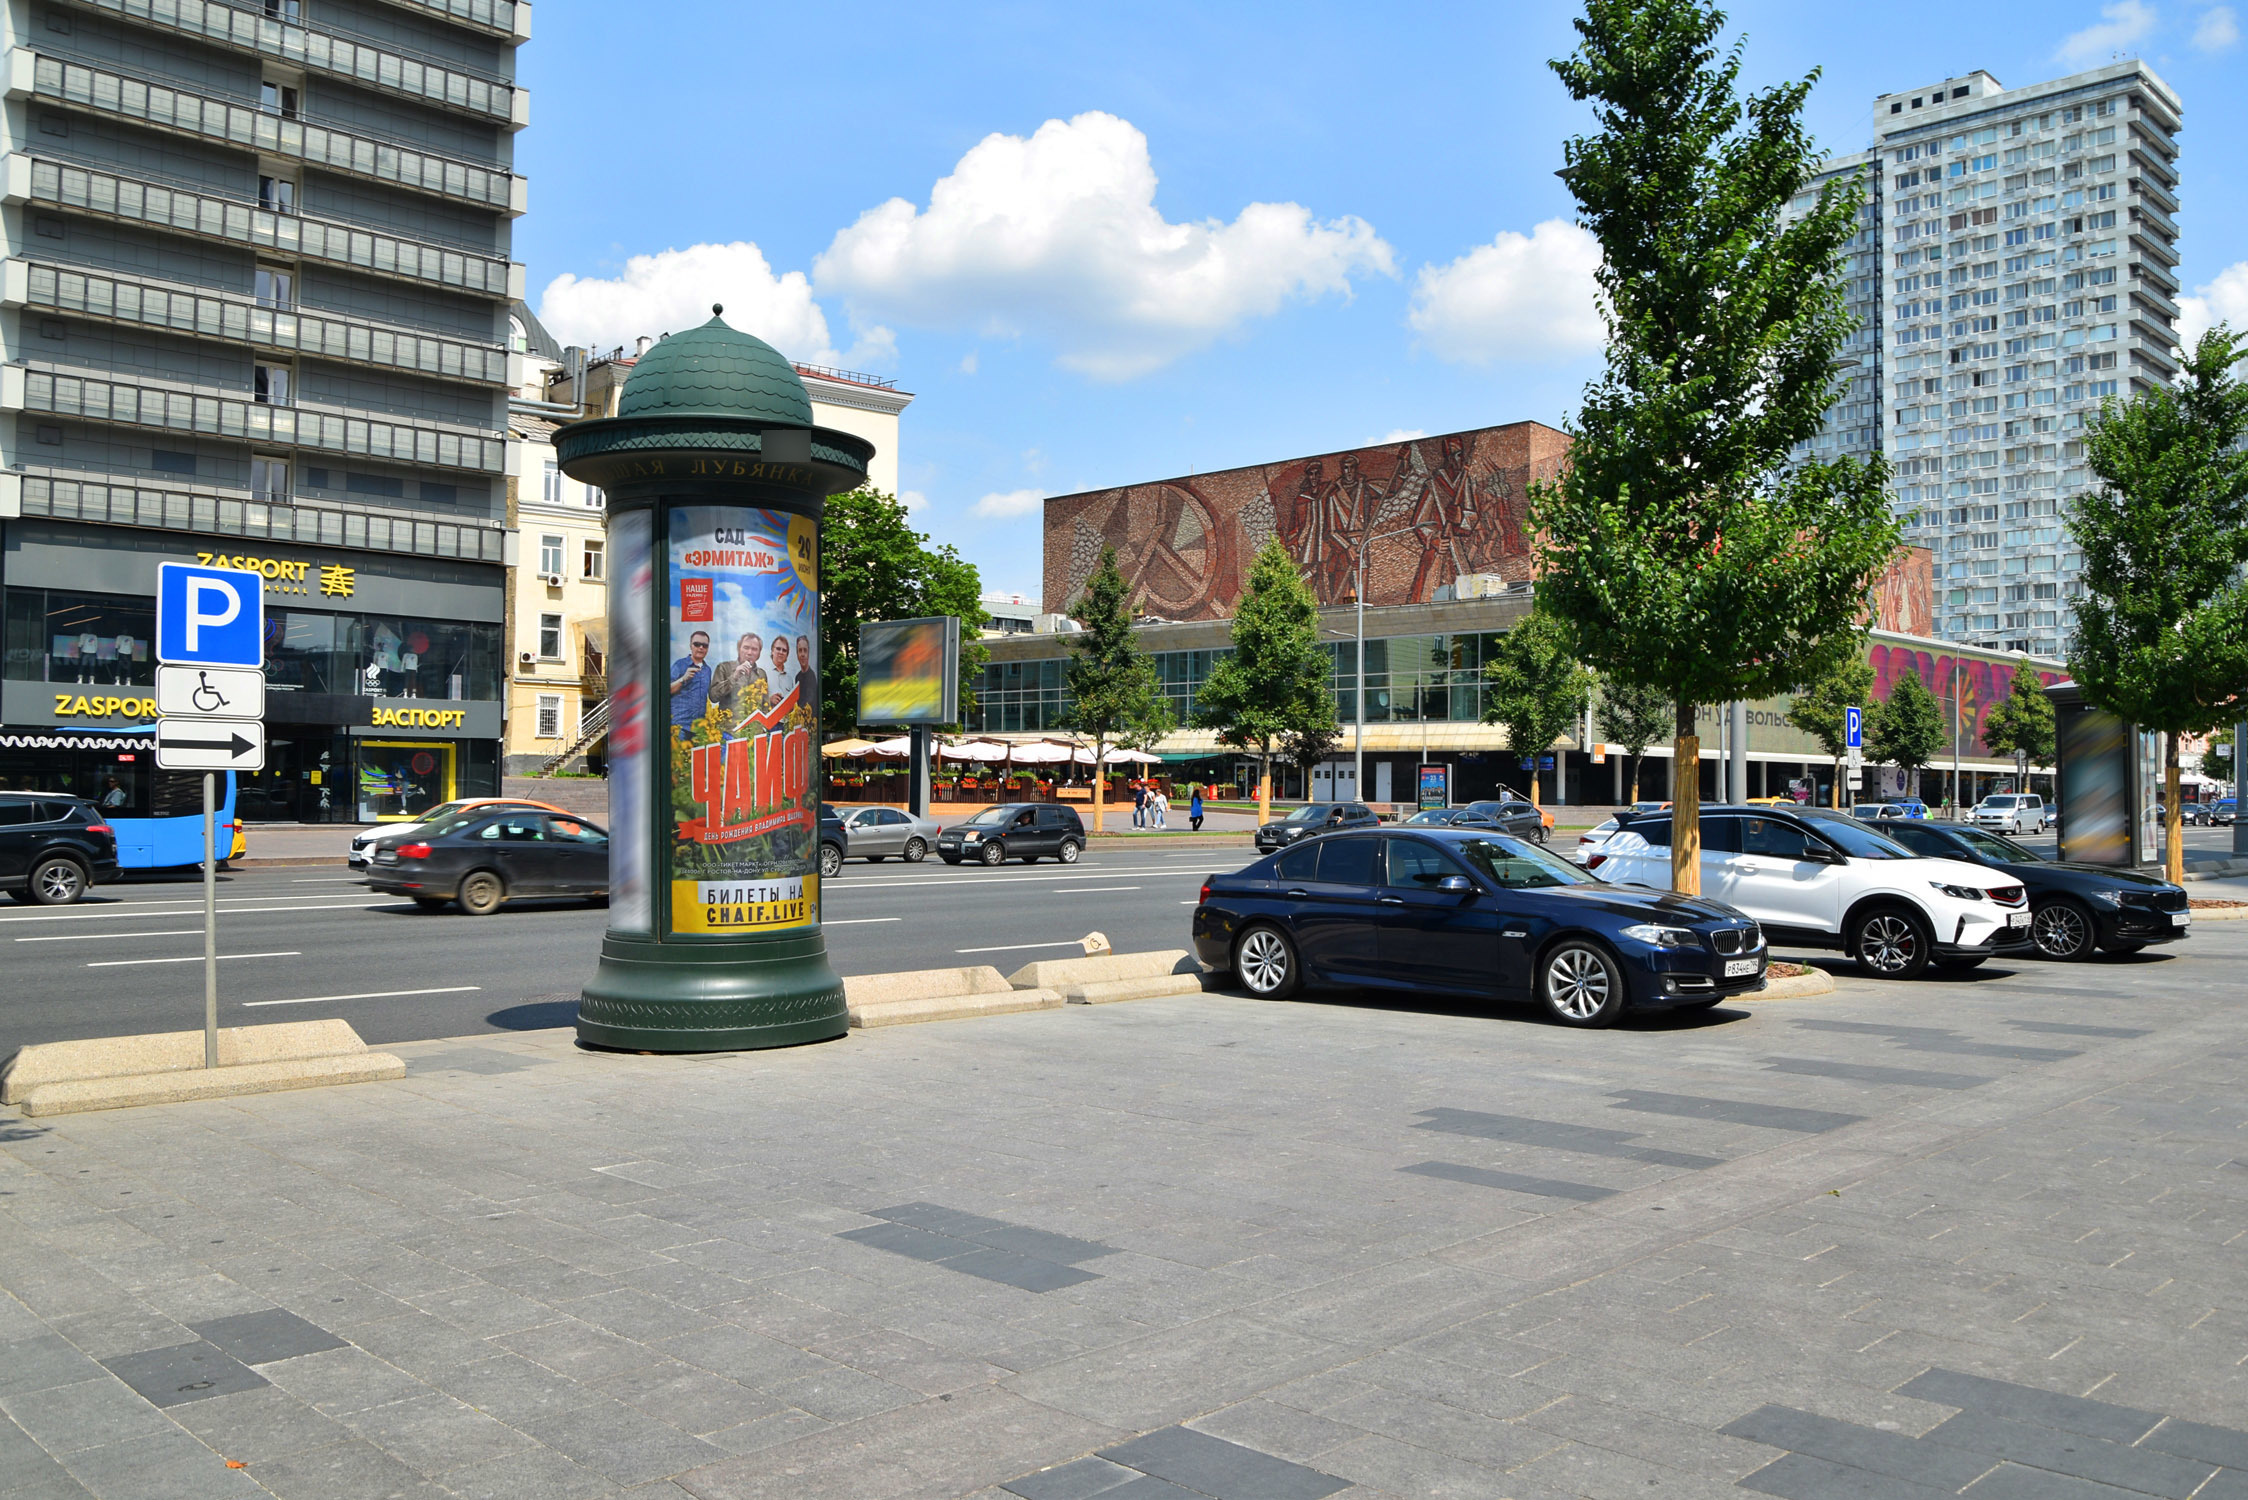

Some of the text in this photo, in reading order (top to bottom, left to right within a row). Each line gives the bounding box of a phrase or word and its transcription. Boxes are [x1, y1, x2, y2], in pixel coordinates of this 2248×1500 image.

[691, 459, 813, 484] ЛУБЯНКА
[714, 528, 745, 545] САД
[685, 550, 774, 568] «ЭРМИТАЖ»
[798, 535, 811, 561] 29
[197, 552, 310, 581] ZASPORT
[264, 584, 308, 595] ASUAL
[686, 584, 708, 593] НАШЕ
[186, 576, 241, 652] P
[54, 694, 158, 718] ZASPOR
[371, 707, 465, 727] ЗАСПОРТ
[691, 725, 809, 828] ЧАЙФ
[704, 832, 719, 841] ДЕНЬ
[721, 827, 753, 840] РОЖДЕНИЯ
[755, 815, 786, 832] ВЛАДИМИРА
[708, 884, 804, 904] БИЛЕТЫ НА
[707, 902, 804, 923] CHAIF.LIVE
